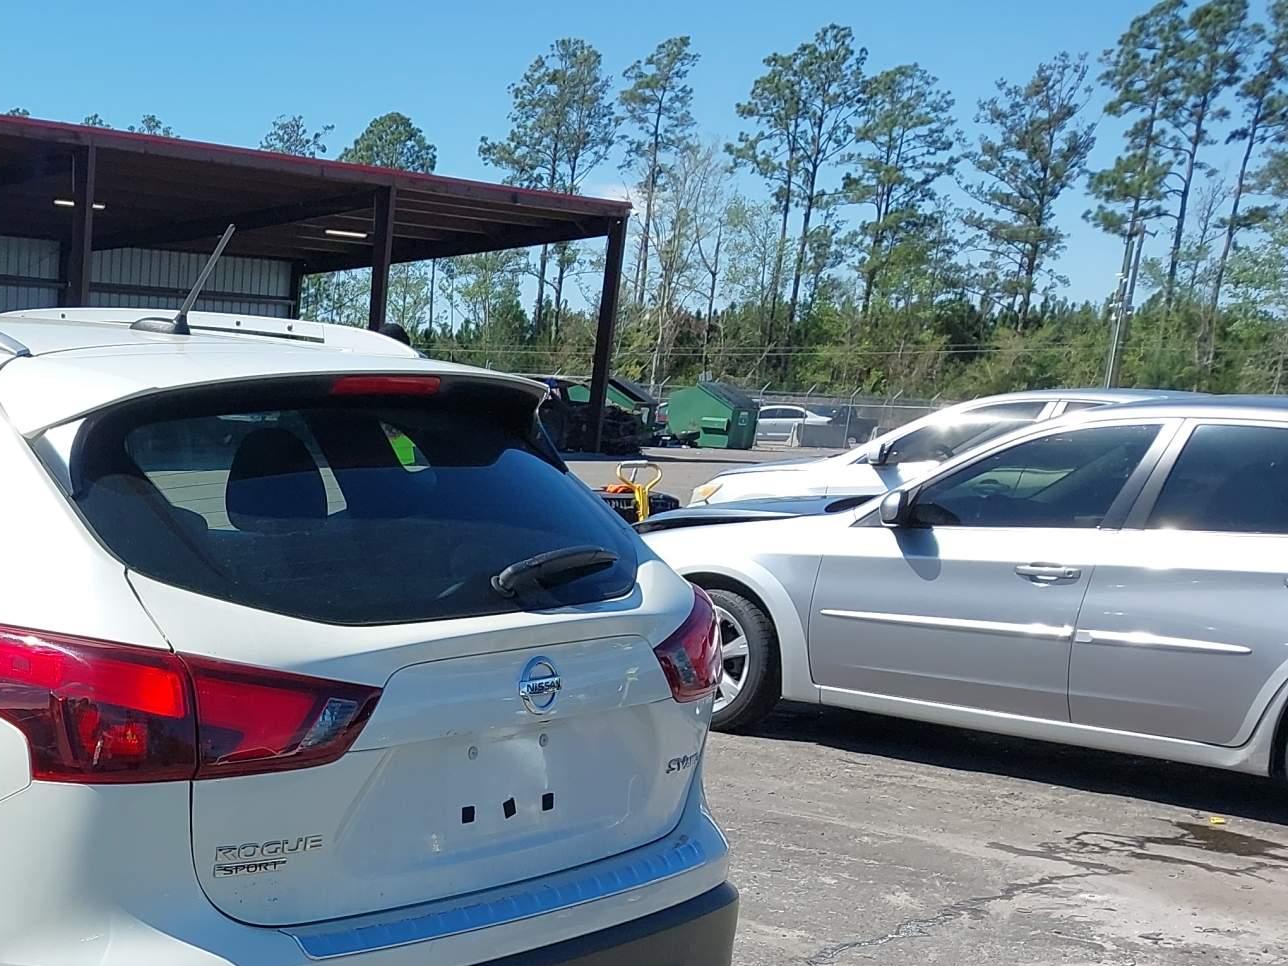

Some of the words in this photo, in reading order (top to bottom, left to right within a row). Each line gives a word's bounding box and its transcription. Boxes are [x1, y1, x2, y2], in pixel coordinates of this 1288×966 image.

[526, 677, 561, 693] NISSAN
[215, 834, 323, 862] ROGUE
[223, 861, 279, 876] SPORT
